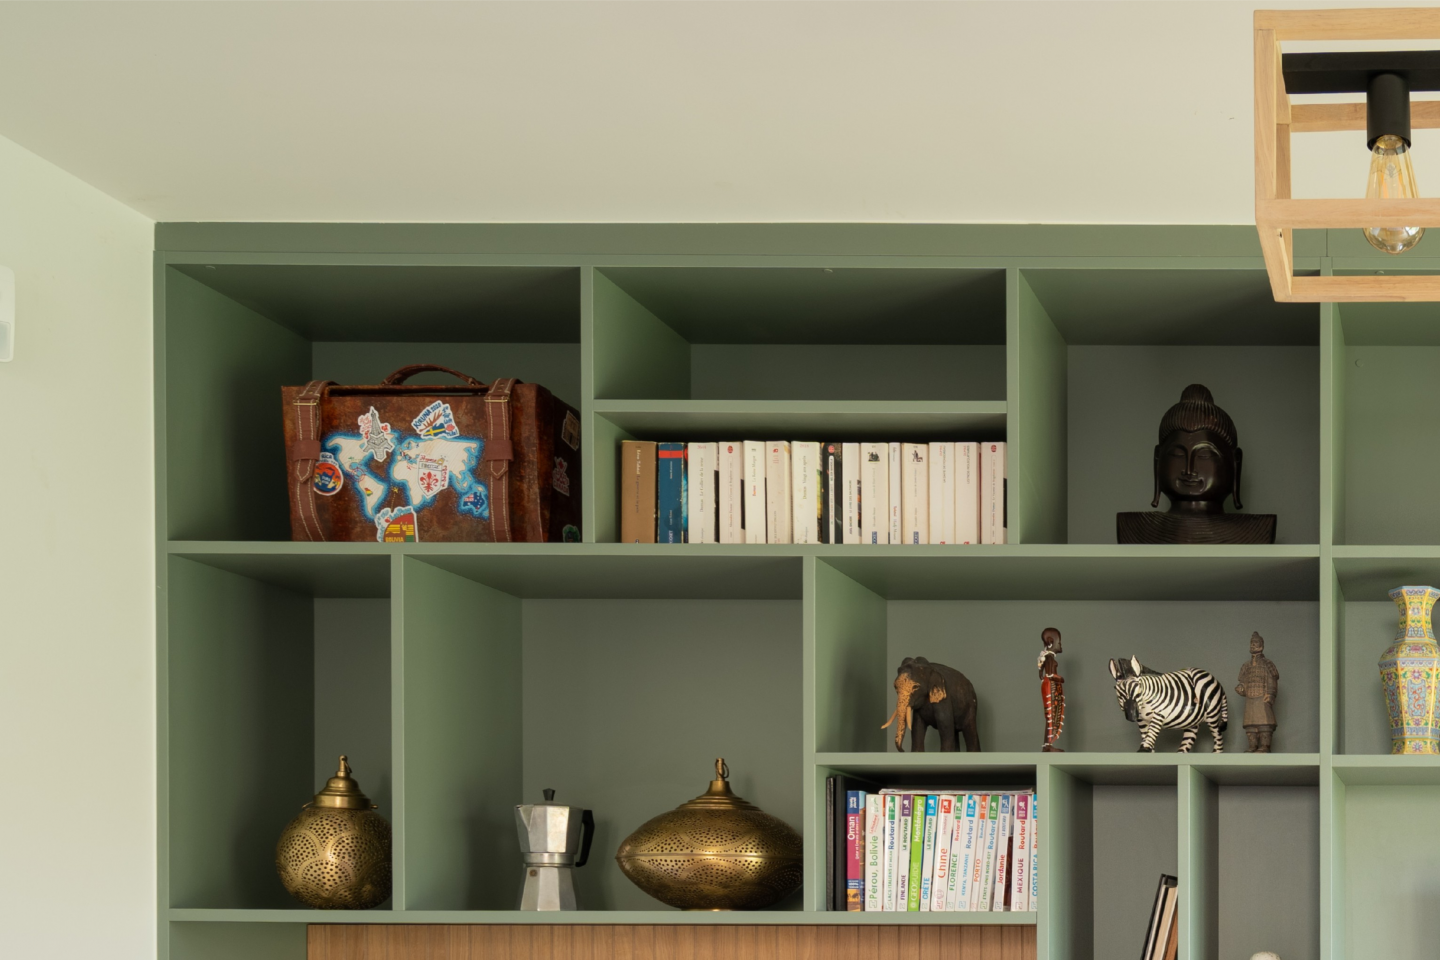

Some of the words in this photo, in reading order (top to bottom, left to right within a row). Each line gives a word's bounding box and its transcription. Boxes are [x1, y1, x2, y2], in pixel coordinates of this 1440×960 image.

[413, 408, 431, 429] KIRUNA
[847, 816, 856, 840] Oman
[914, 799, 924, 842] Monténégro
[988, 821, 996, 849] Routard
[870, 836, 878, 866] Bolivie
[938, 848, 947, 878] Chine
[949, 853, 958, 891] FLORENCE
[973, 859, 981, 882] PORTO
[997, 854, 1005, 885] Jordanie
[868, 870, 879, 899] Pérou,
[922, 878, 930, 899] CRÊTE
